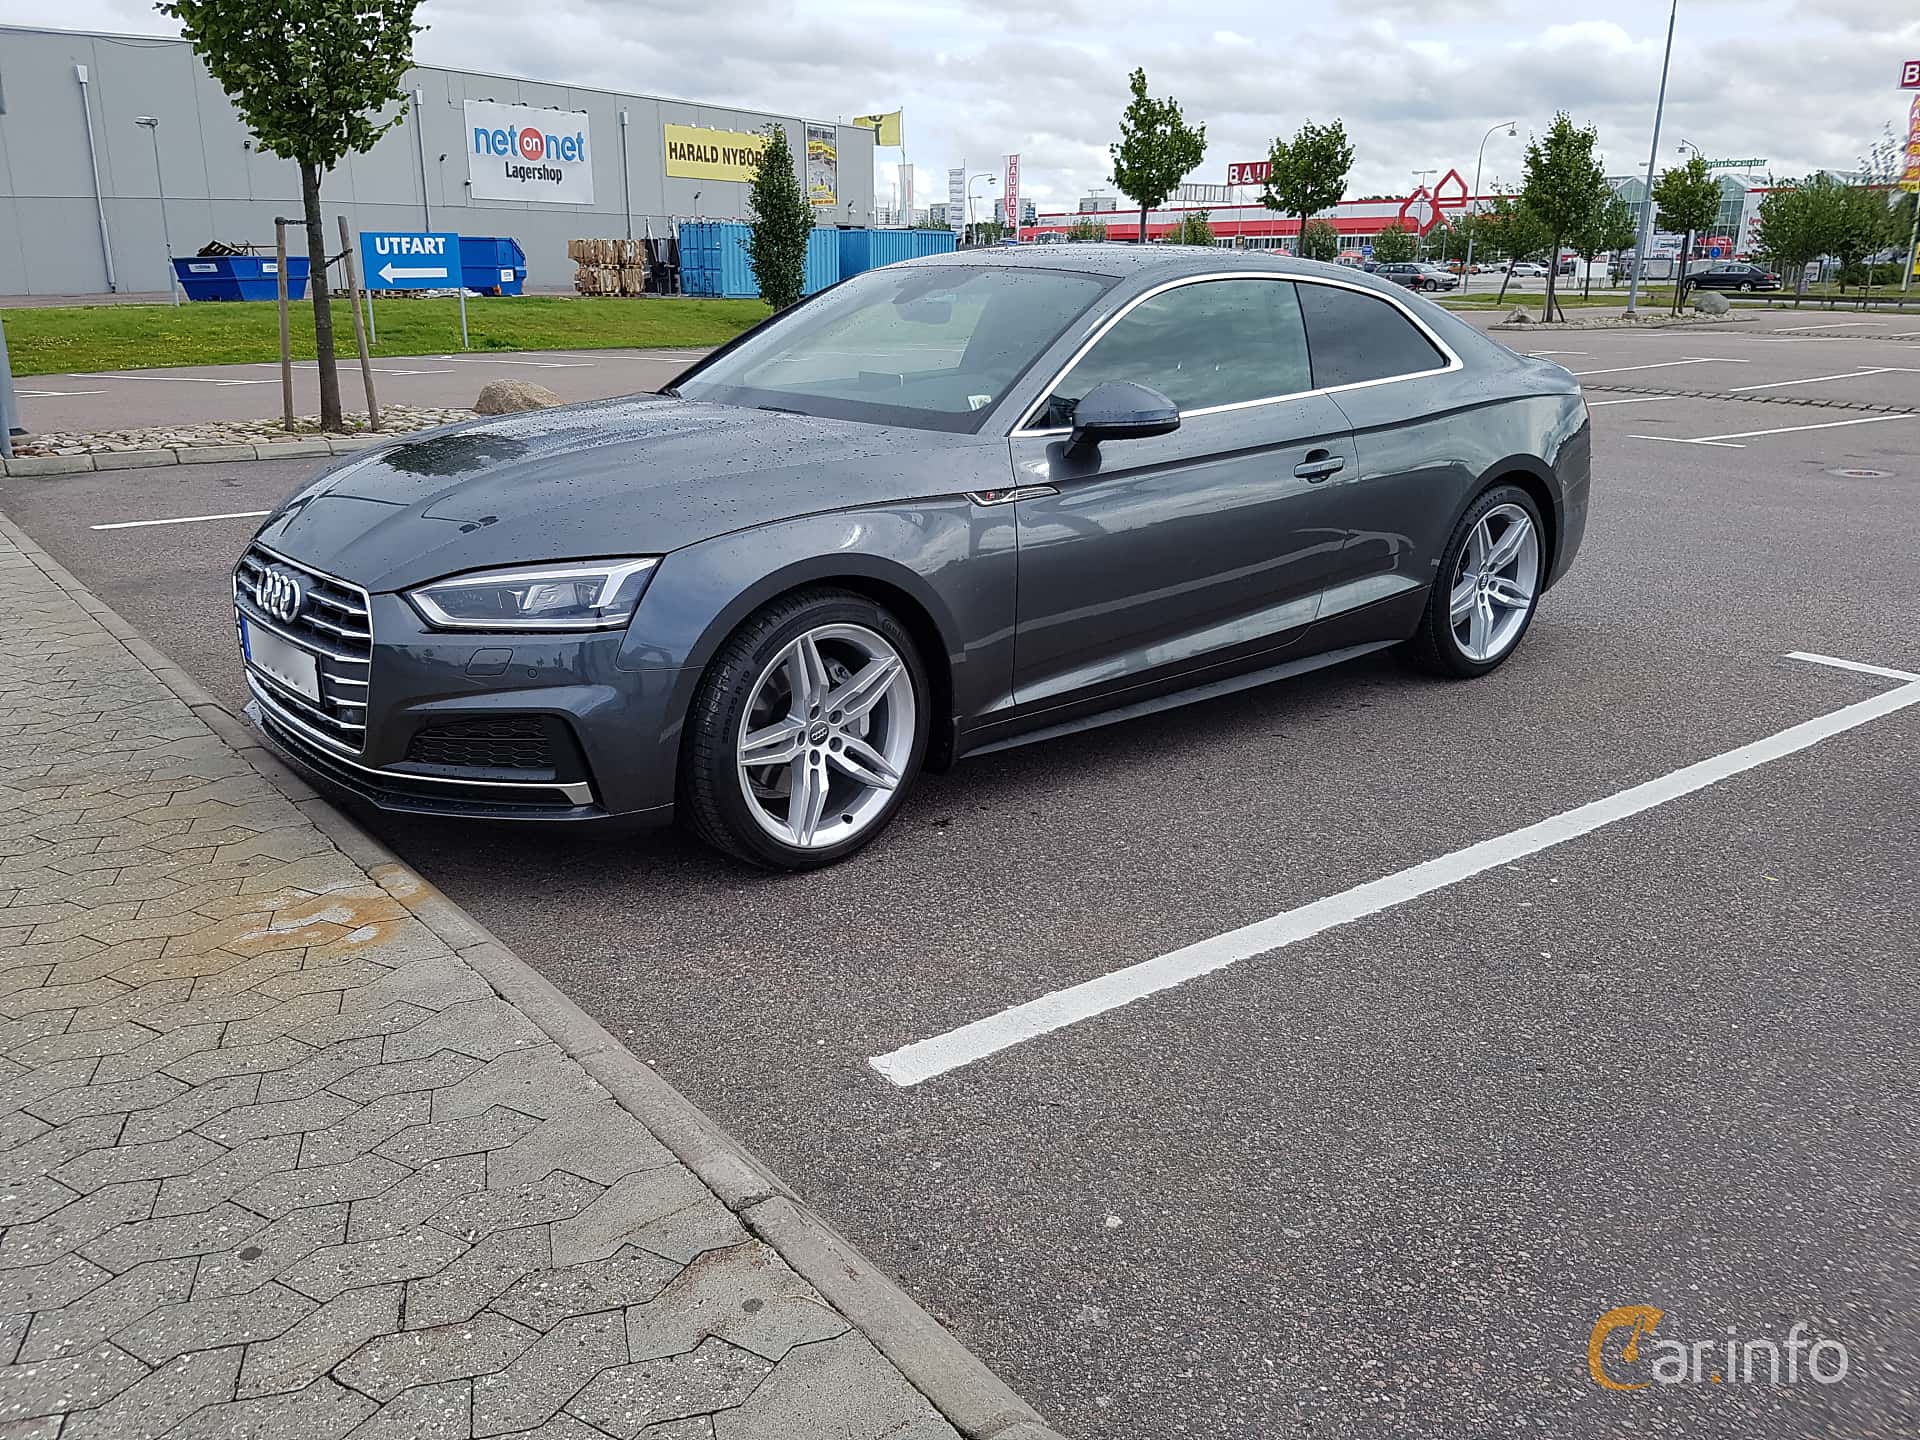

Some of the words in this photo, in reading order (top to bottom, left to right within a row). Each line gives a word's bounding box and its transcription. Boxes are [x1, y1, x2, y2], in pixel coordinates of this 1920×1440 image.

[668, 141, 719, 164] HARALD
[722, 146, 763, 167] NYBÖR
[505, 160, 563, 185] Lagershop
[1229, 163, 1267, 185] BAU
[375, 237, 446, 255] UTFART
